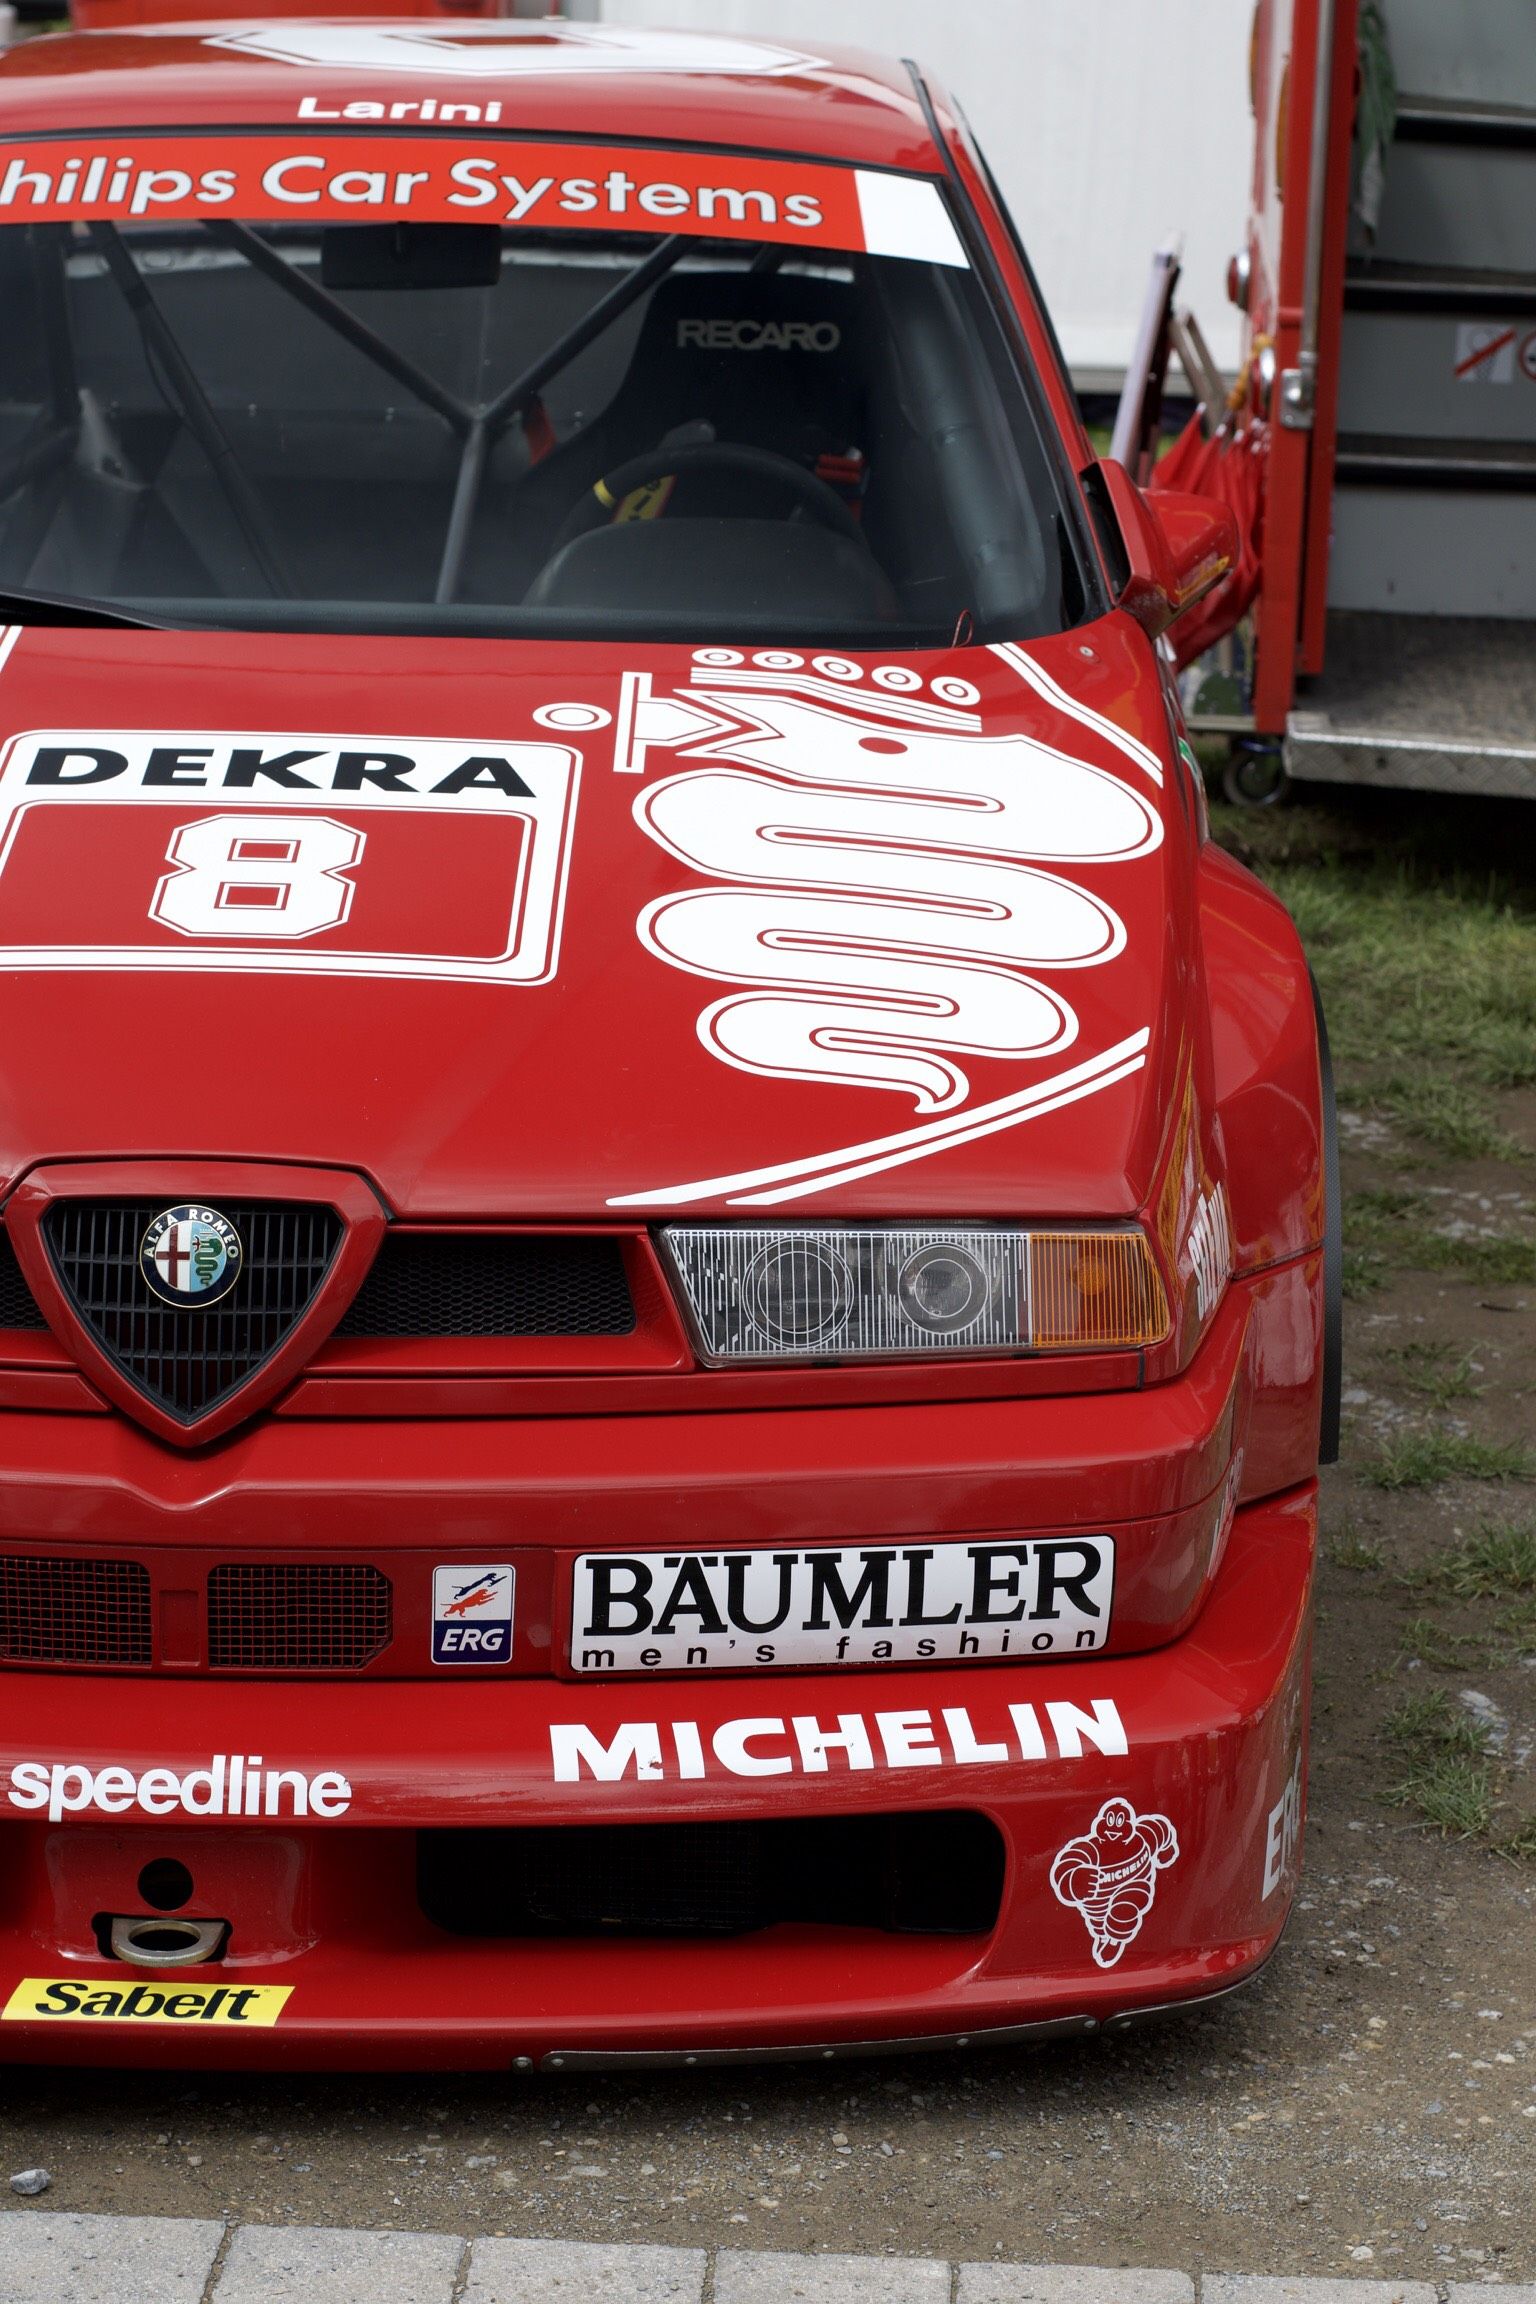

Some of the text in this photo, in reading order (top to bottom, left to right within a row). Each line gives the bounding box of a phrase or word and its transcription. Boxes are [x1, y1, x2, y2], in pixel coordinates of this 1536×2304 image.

[297, 97, 502, 122] Larini
[262, 155, 428, 204] Car
[448, 158, 822, 226] Systems
[677, 319, 841, 352] RECARO
[26, 747, 536, 798] DEKRA
[147, 813, 367, 939] 8
[144, 1208, 239, 1258] ALFA ROMEO
[583, 1541, 1102, 1637] BÄUMLER
[441, 1628, 505, 1651] ERG
[582, 1628, 1096, 1668] men's fashion
[550, 1699, 1129, 1783] MICHELIN
[7, 1755, 352, 1822] speedline
[1100, 1851, 1149, 1884] MICHELIN
[35, 1982, 260, 2020] Sabelt
